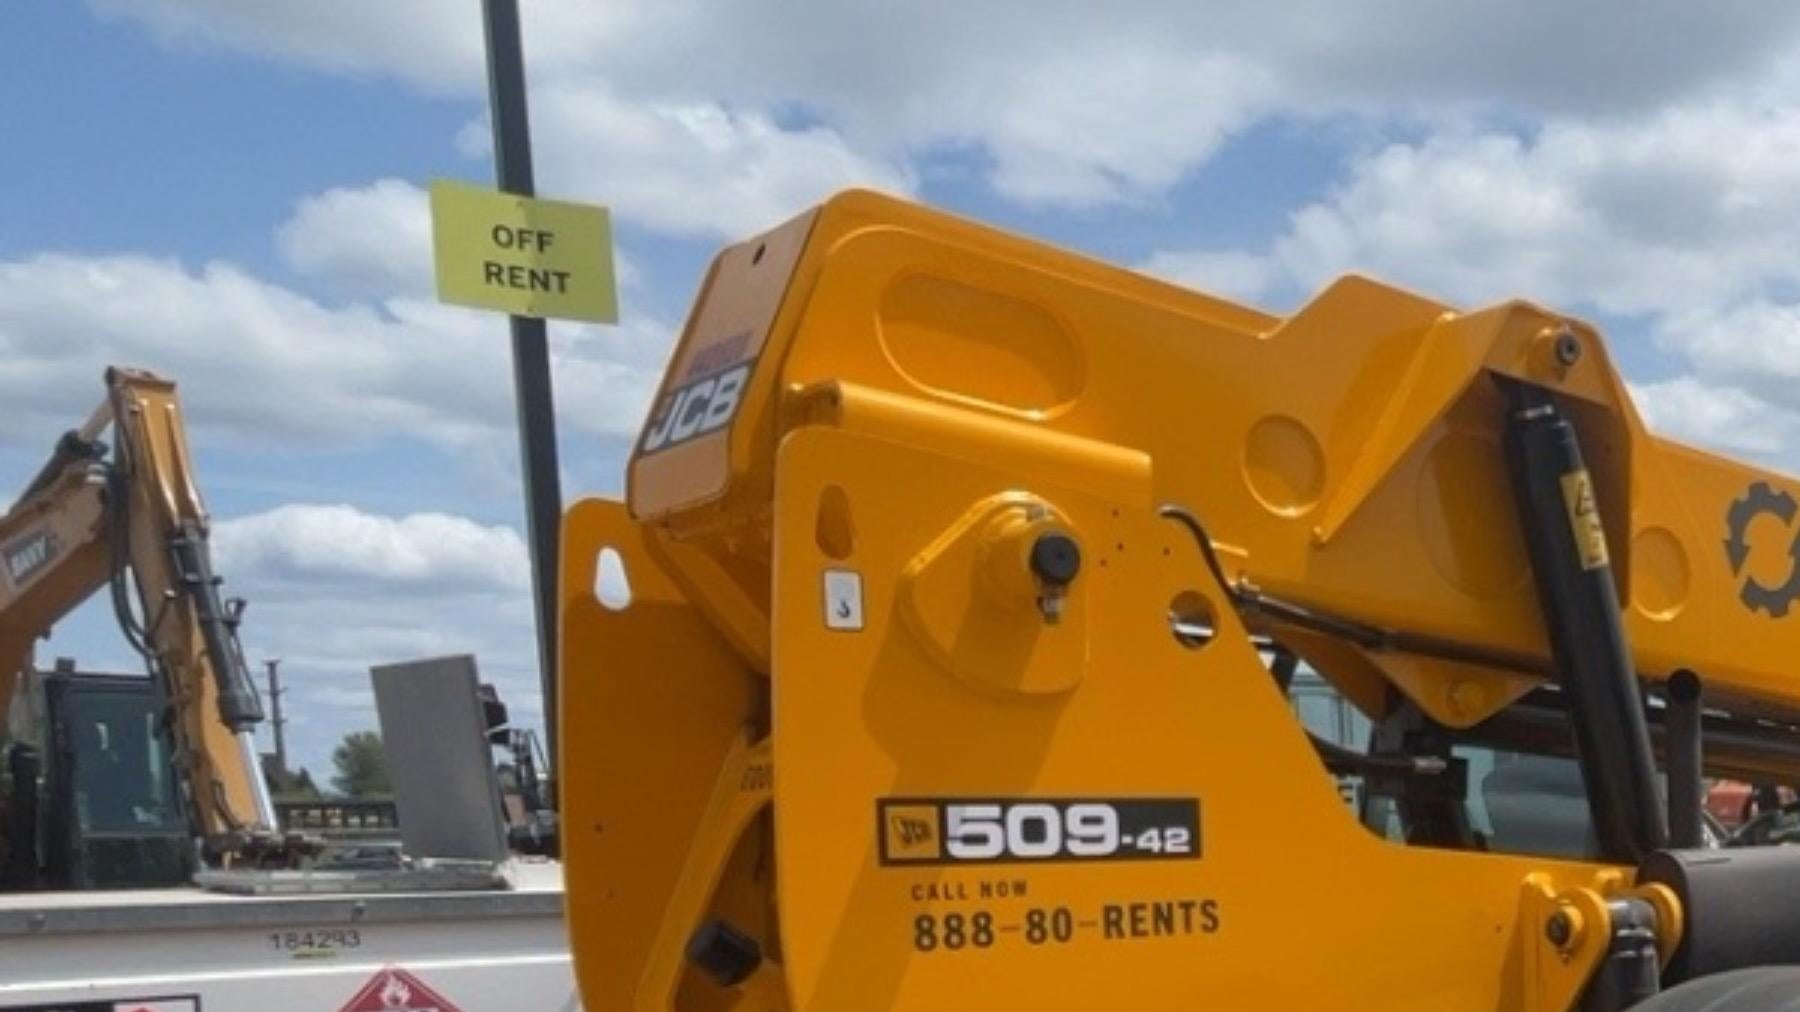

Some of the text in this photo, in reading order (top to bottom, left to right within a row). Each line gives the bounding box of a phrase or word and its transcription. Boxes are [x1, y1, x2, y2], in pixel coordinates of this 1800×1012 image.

[490, 222, 556, 255] OFF
[482, 260, 572, 295] RENT
[643, 364, 750, 451] JCB
[946, 803, 1191, 860] 509-42
[910, 879, 1029, 902] CALL NOW
[913, 899, 1221, 953] 888-80-RENTS
